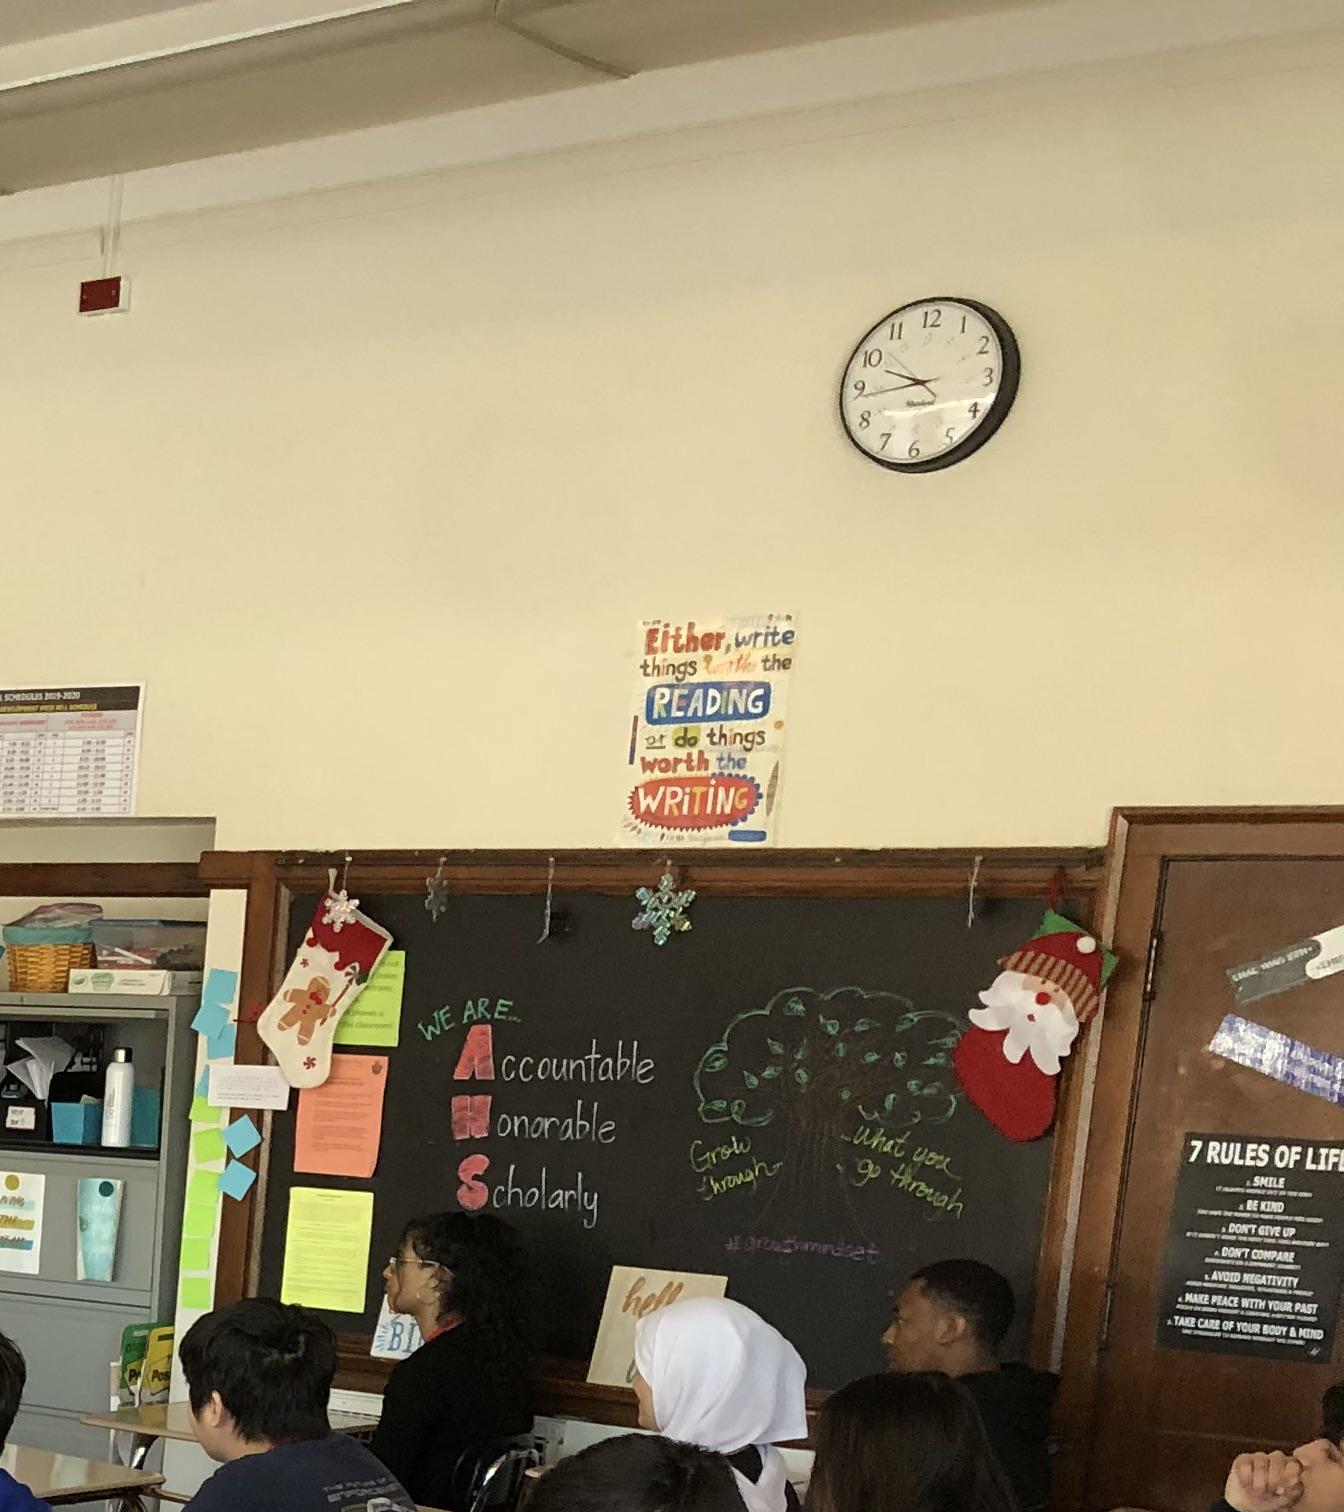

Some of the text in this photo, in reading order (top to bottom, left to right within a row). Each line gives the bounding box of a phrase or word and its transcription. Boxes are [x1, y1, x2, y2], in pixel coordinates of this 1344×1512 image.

[922, 309, 942, 328] 12
[960, 315, 967, 334] 1
[889, 322, 904, 341] 11
[977, 335, 990, 355] 2
[861, 348, 883, 368] 10
[983, 367, 993, 386] 3
[853, 380, 866, 400] 9
[858, 410, 872, 430] 8
[968, 401, 981, 420] 4
[879, 432, 892, 452] 7
[945, 427, 955, 444] 5
[908, 440, 921, 458] 6
[644, 621, 796, 655] Either, write
[640, 658, 697, 683] things
[761, 652, 793, 674] the
[652, 686, 765, 719] READING
[674, 727, 698, 748] do
[707, 726, 766, 752] things
[640, 750, 748, 774] worth the
[418, 1005, 455, 1041] WE
[453, 1024, 655, 1084] Accountable
[451, 1095, 616, 1144] Honorable
[689, 1136, 751, 1172] Grow
[1188, 1140, 1203, 1163] 7
[1206, 1141, 1270, 1168] RULES
[1274, 1145, 1303, 1169] OF
[456, 1154, 599, 1229] Scholarly
[1253, 1175, 1286, 1189] SMILE
[1246, 1199, 1285, 1213] BE KIND
[1228, 1222, 1297, 1239] DON'T GIVE UP
[1221, 1246, 1295, 1263] DON'T COMPARE
[1212, 1270, 1241, 1283] AVOID
[1242, 1272, 1299, 1289] NEGATIVITY
[1184, 1292, 1210, 1305] MAKE
[1211, 1295, 1240, 1308] PEACE
[1241, 1297, 1266, 1311] WITH
[1267, 1300, 1293, 1313] YOUR
[1294, 1302, 1319, 1316] PAST
[1173, 1315, 1196, 1328] TAKE
[1197, 1318, 1221, 1331] CARE
[1222, 1321, 1235, 1332] OF
[1236, 1322, 1261, 1335] YOUR
[1262, 1325, 1288, 1337] BODY
[1298, 1327, 1324, 1340] MIND
